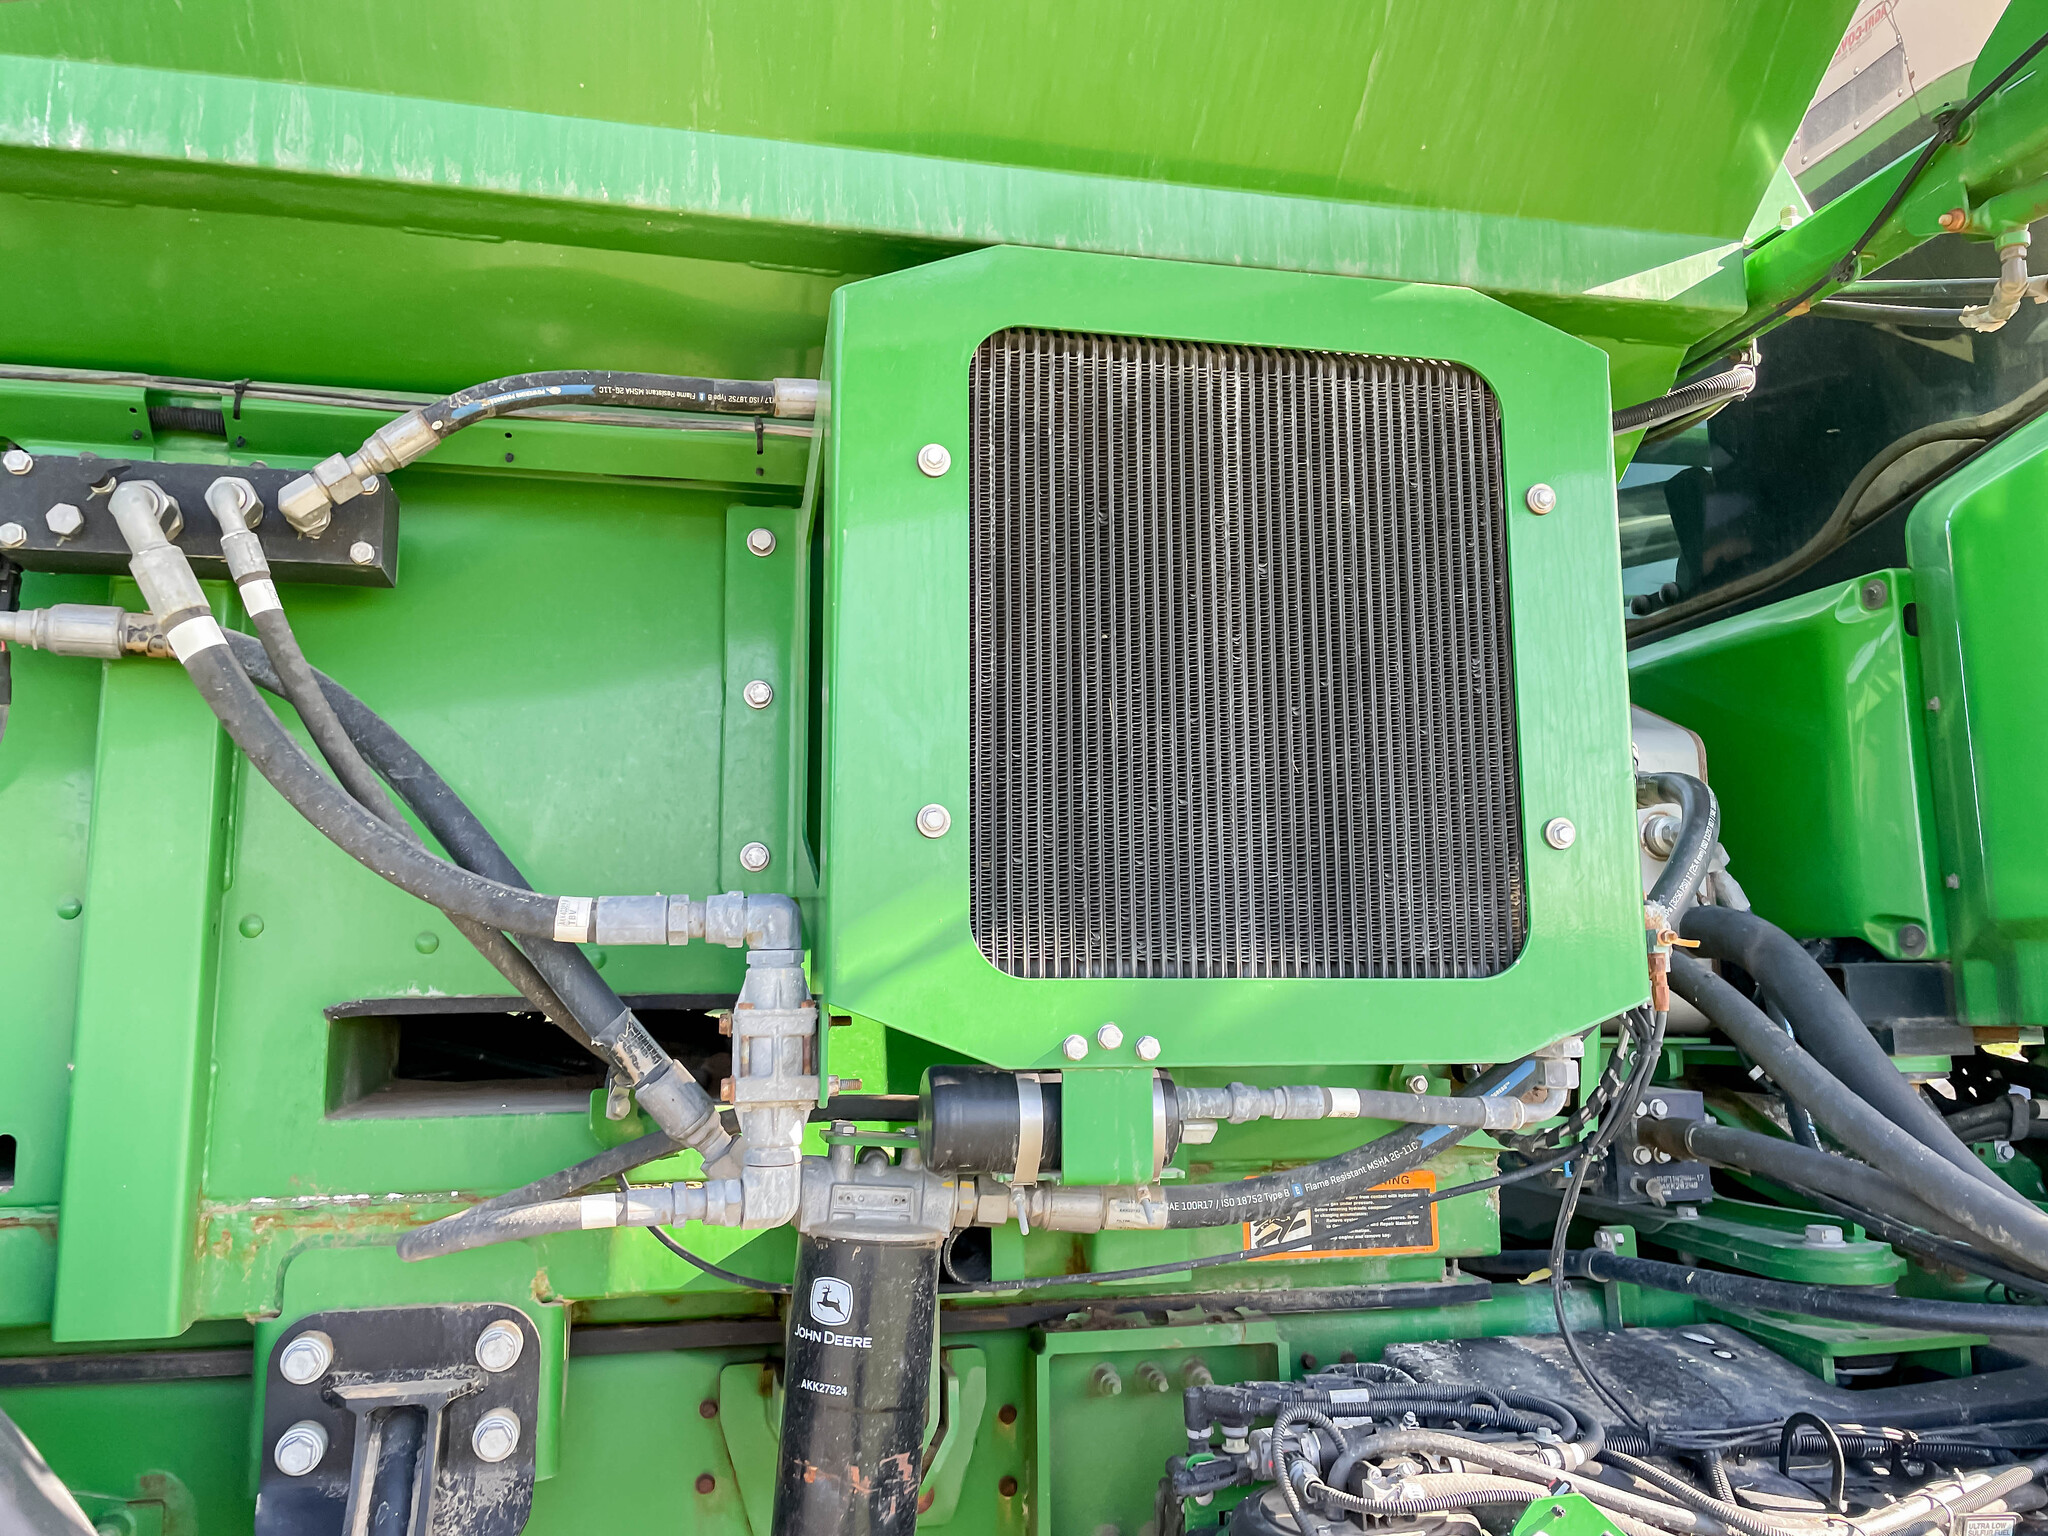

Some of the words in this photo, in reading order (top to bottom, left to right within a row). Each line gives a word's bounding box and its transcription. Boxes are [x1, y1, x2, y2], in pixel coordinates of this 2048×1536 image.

[626, 387, 645, 396] MSHA
[645, 389, 676, 398] Resistant
[676, 391, 696, 400] Flame
[707, 393, 713, 401] B
[713, 393, 727, 402] Type
[728, 394, 748, 403] 18752
[749, 395, 760, 404] ISO
[1304, 1179, 1330, 1192] Flame
[1330, 1165, 1367, 1184] Resistant
[1366, 1156, 1390, 1171] MSHA
[1388, 1141, 1419, 1162] 2G-11C
[1181, 1199, 1214, 1211] 100R17
[1221, 1197, 1235, 1208] ISO
[1237, 1194, 1263, 1206] 18752
[1264, 1190, 1283, 1204] Type
[1283, 1188, 1290, 1198] B
[794, 1323, 822, 1343] JOHN
[823, 1330, 873, 1348] DEERE
[800, 1378, 848, 1396] AKK27524
[1968, 1522, 1990, 1530] ULTRA
